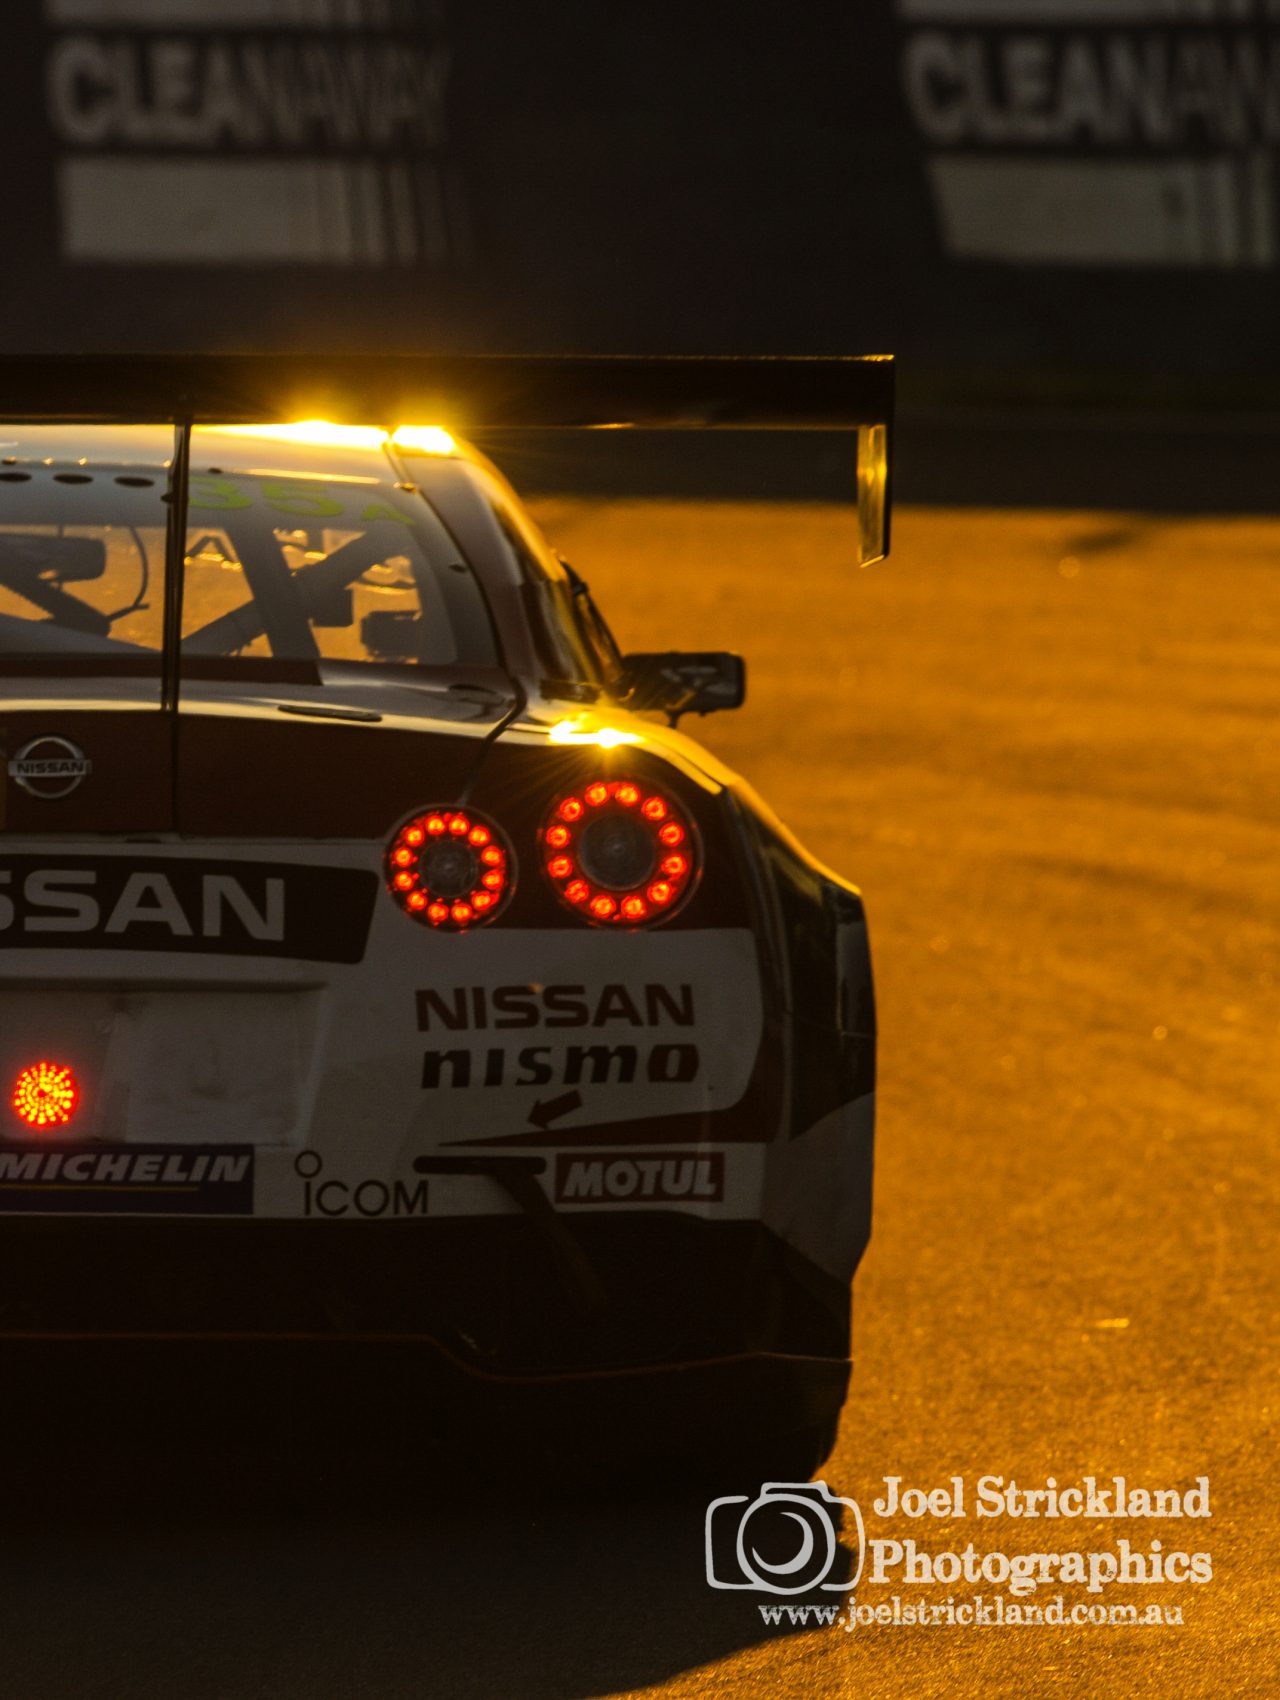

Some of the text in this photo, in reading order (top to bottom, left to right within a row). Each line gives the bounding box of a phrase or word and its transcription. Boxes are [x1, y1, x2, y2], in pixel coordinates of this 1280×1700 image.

[17, 762, 84, 774] NISSAN
[415, 983, 695, 1031] NISSAN
[422, 1043, 700, 1089] nismo
[561, 1160, 720, 1199] MOTUL
